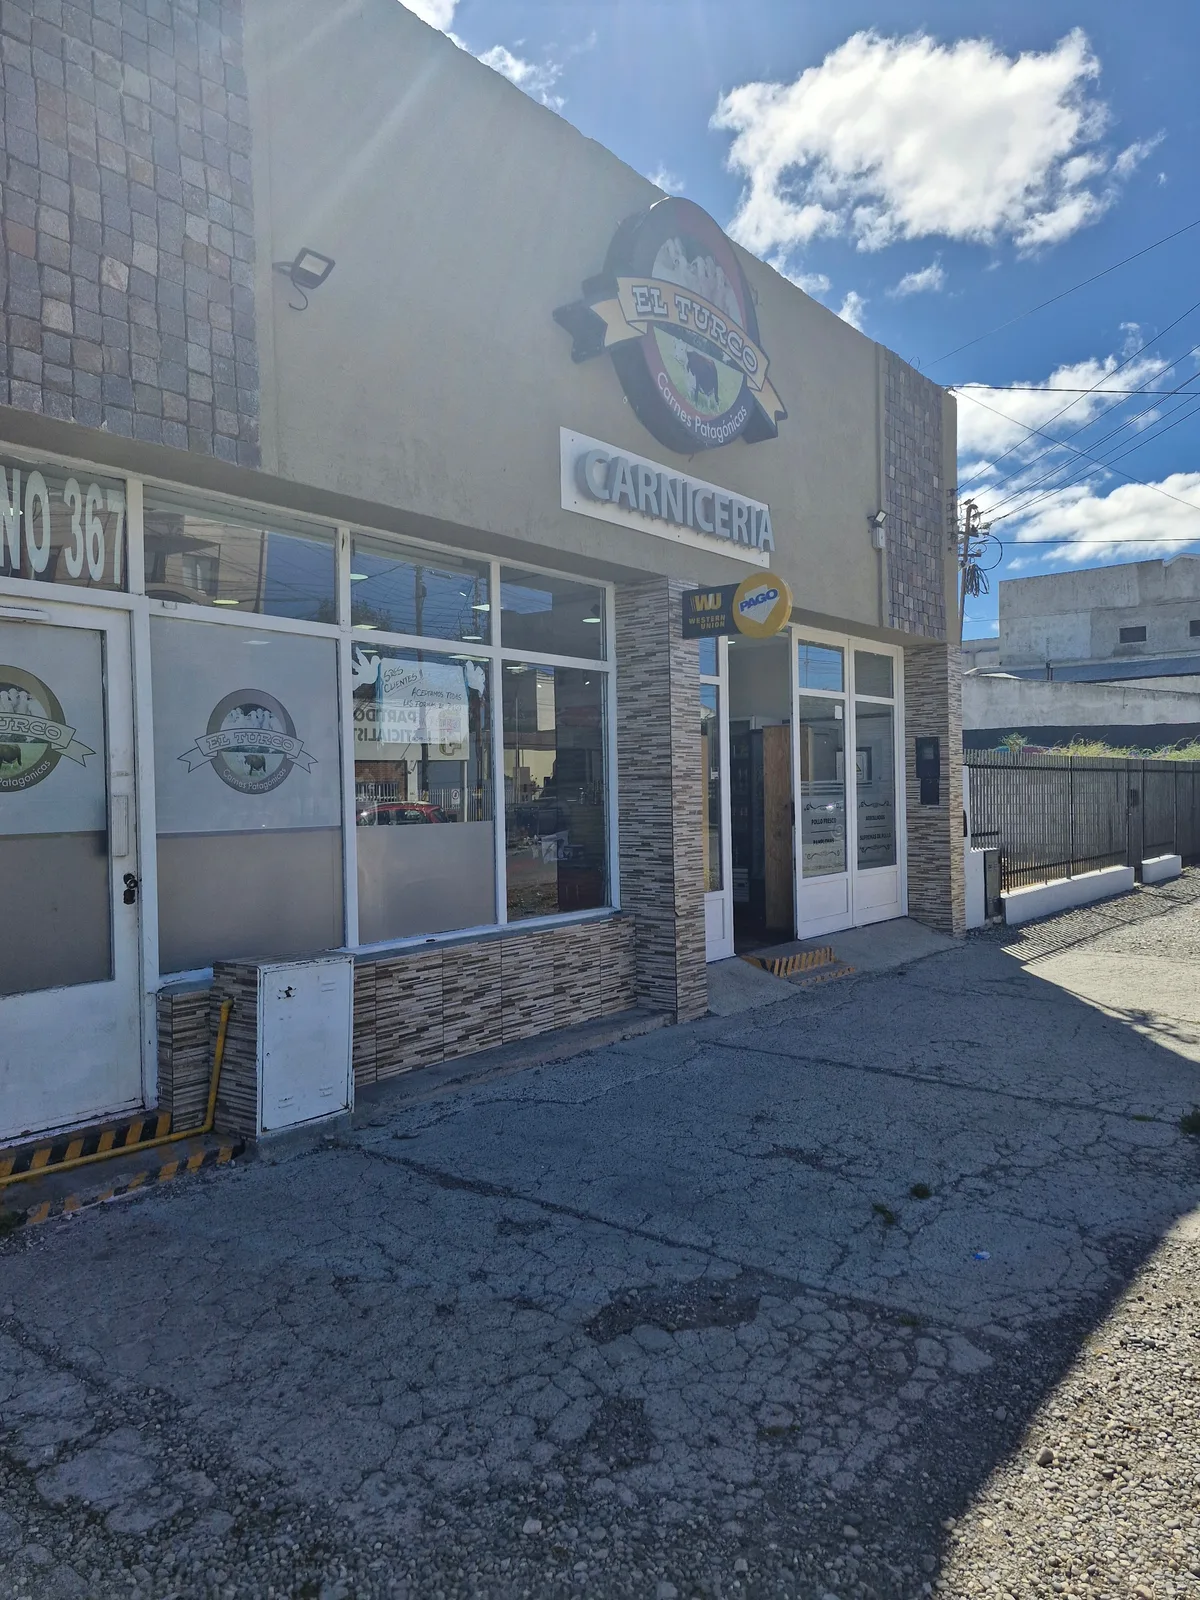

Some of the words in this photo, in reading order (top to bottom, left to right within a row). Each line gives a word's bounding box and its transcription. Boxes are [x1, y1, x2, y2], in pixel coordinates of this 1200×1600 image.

[631, 285, 669, 318] EL
[674, 293, 758, 375] TURCO
[657, 371, 692, 427] Carnes
[694, 405, 748, 444] Patagónicas
[583, 448, 776, 552] CARNICERIA
[63, 477, 125, 585] 367
[740, 588, 779, 613] PAGO
[688, 614, 726, 625] WESTERN
[700, 621, 725, 630] UNION
[205, 733, 231, 751] EL
[233, 731, 294, 752] TURCO
[0, 760, 51, 788] atagónicas
[223, 768, 247, 789] Carnes
[247, 767, 287, 790] Patagónicas
